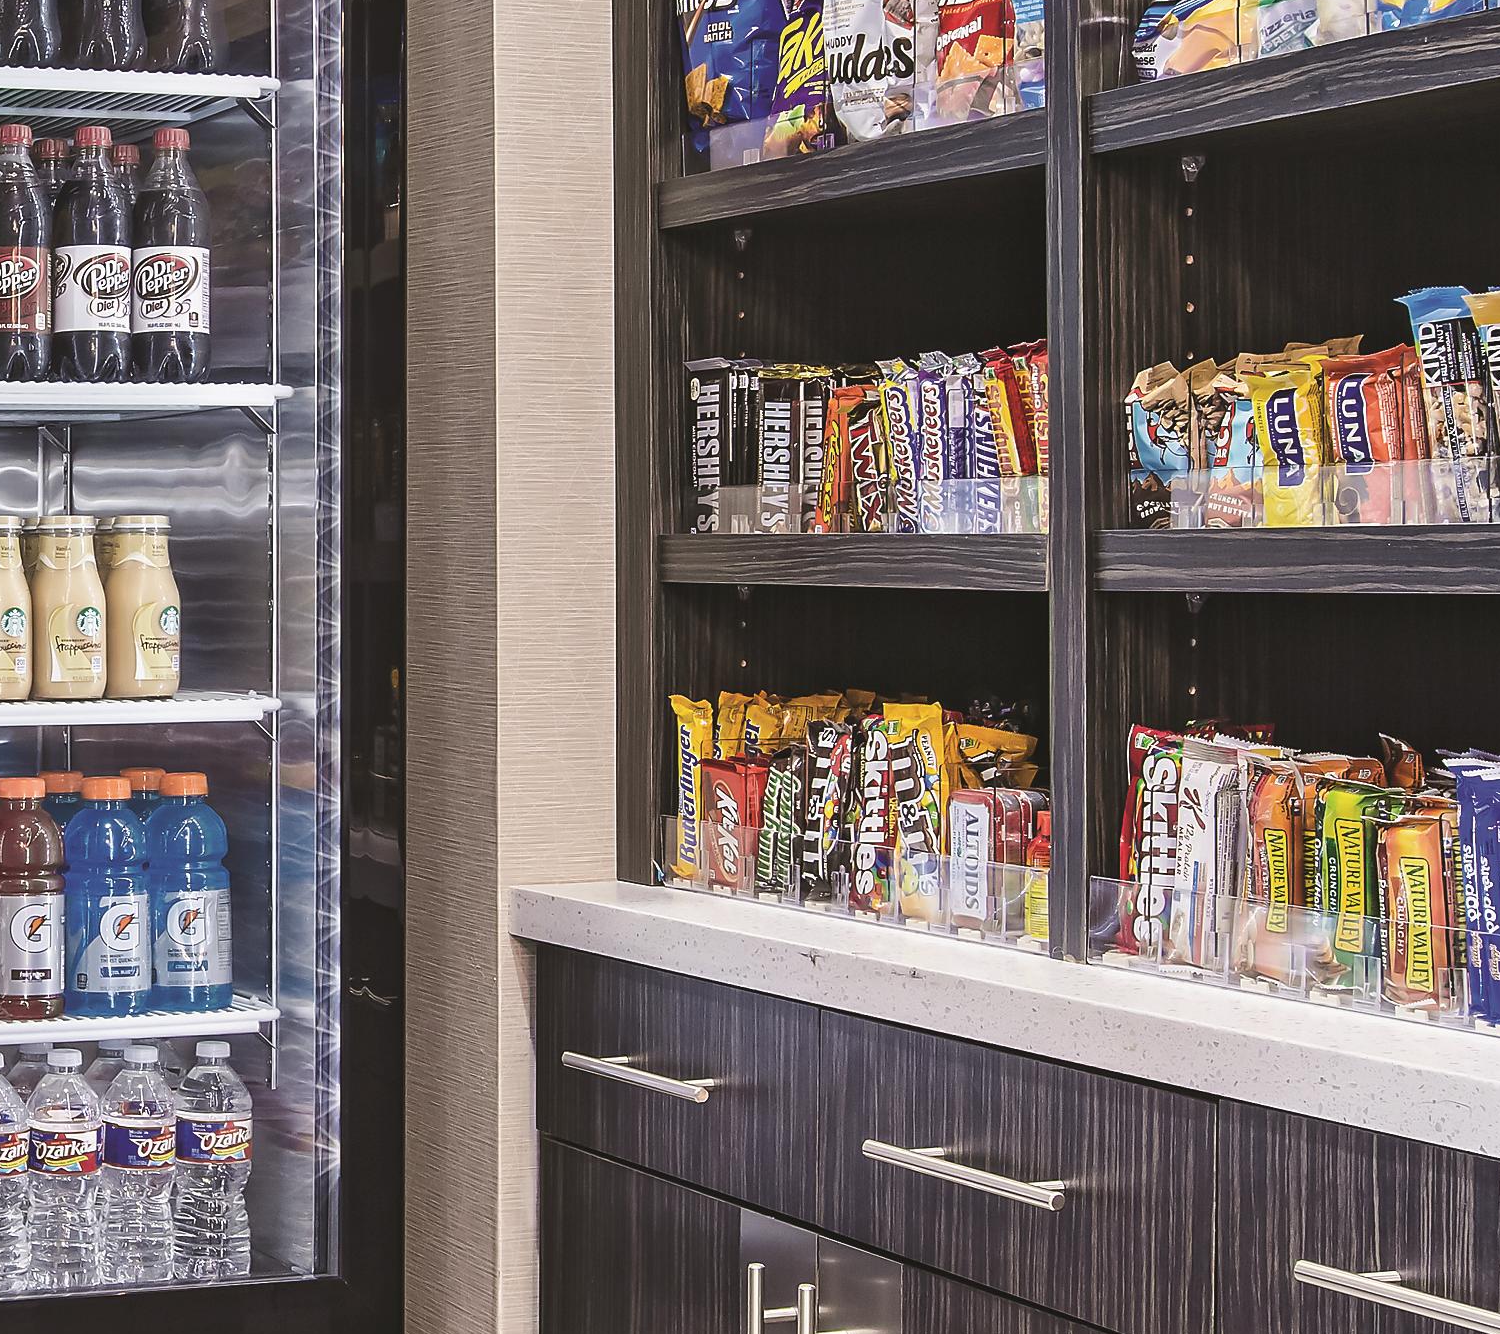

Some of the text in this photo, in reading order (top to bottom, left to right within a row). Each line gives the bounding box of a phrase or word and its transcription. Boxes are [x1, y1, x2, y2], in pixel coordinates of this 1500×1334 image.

[703, 29, 733, 43] RANCH
[707, 21, 732, 33] COOL
[1, 261, 23, 280] Dr
[90, 267, 130, 295] Pepper
[106, 258, 125, 278] Dr
[152, 259, 174, 279] Dr
[96, 299, 118, 314] Diet
[143, 300, 165, 314] Diet
[1419, 323, 1441, 387] KIND
[1273, 396, 1300, 478] LUNA
[1340, 381, 1367, 463] LUNA
[696, 384, 721, 532] HERSHEY'S
[760, 402, 792, 527] HERSHEY'S
[679, 725, 701, 865] Butterfinger
[1135, 754, 1179, 942] Skittles
[1268, 833, 1287, 931] NATURE VALLEY
